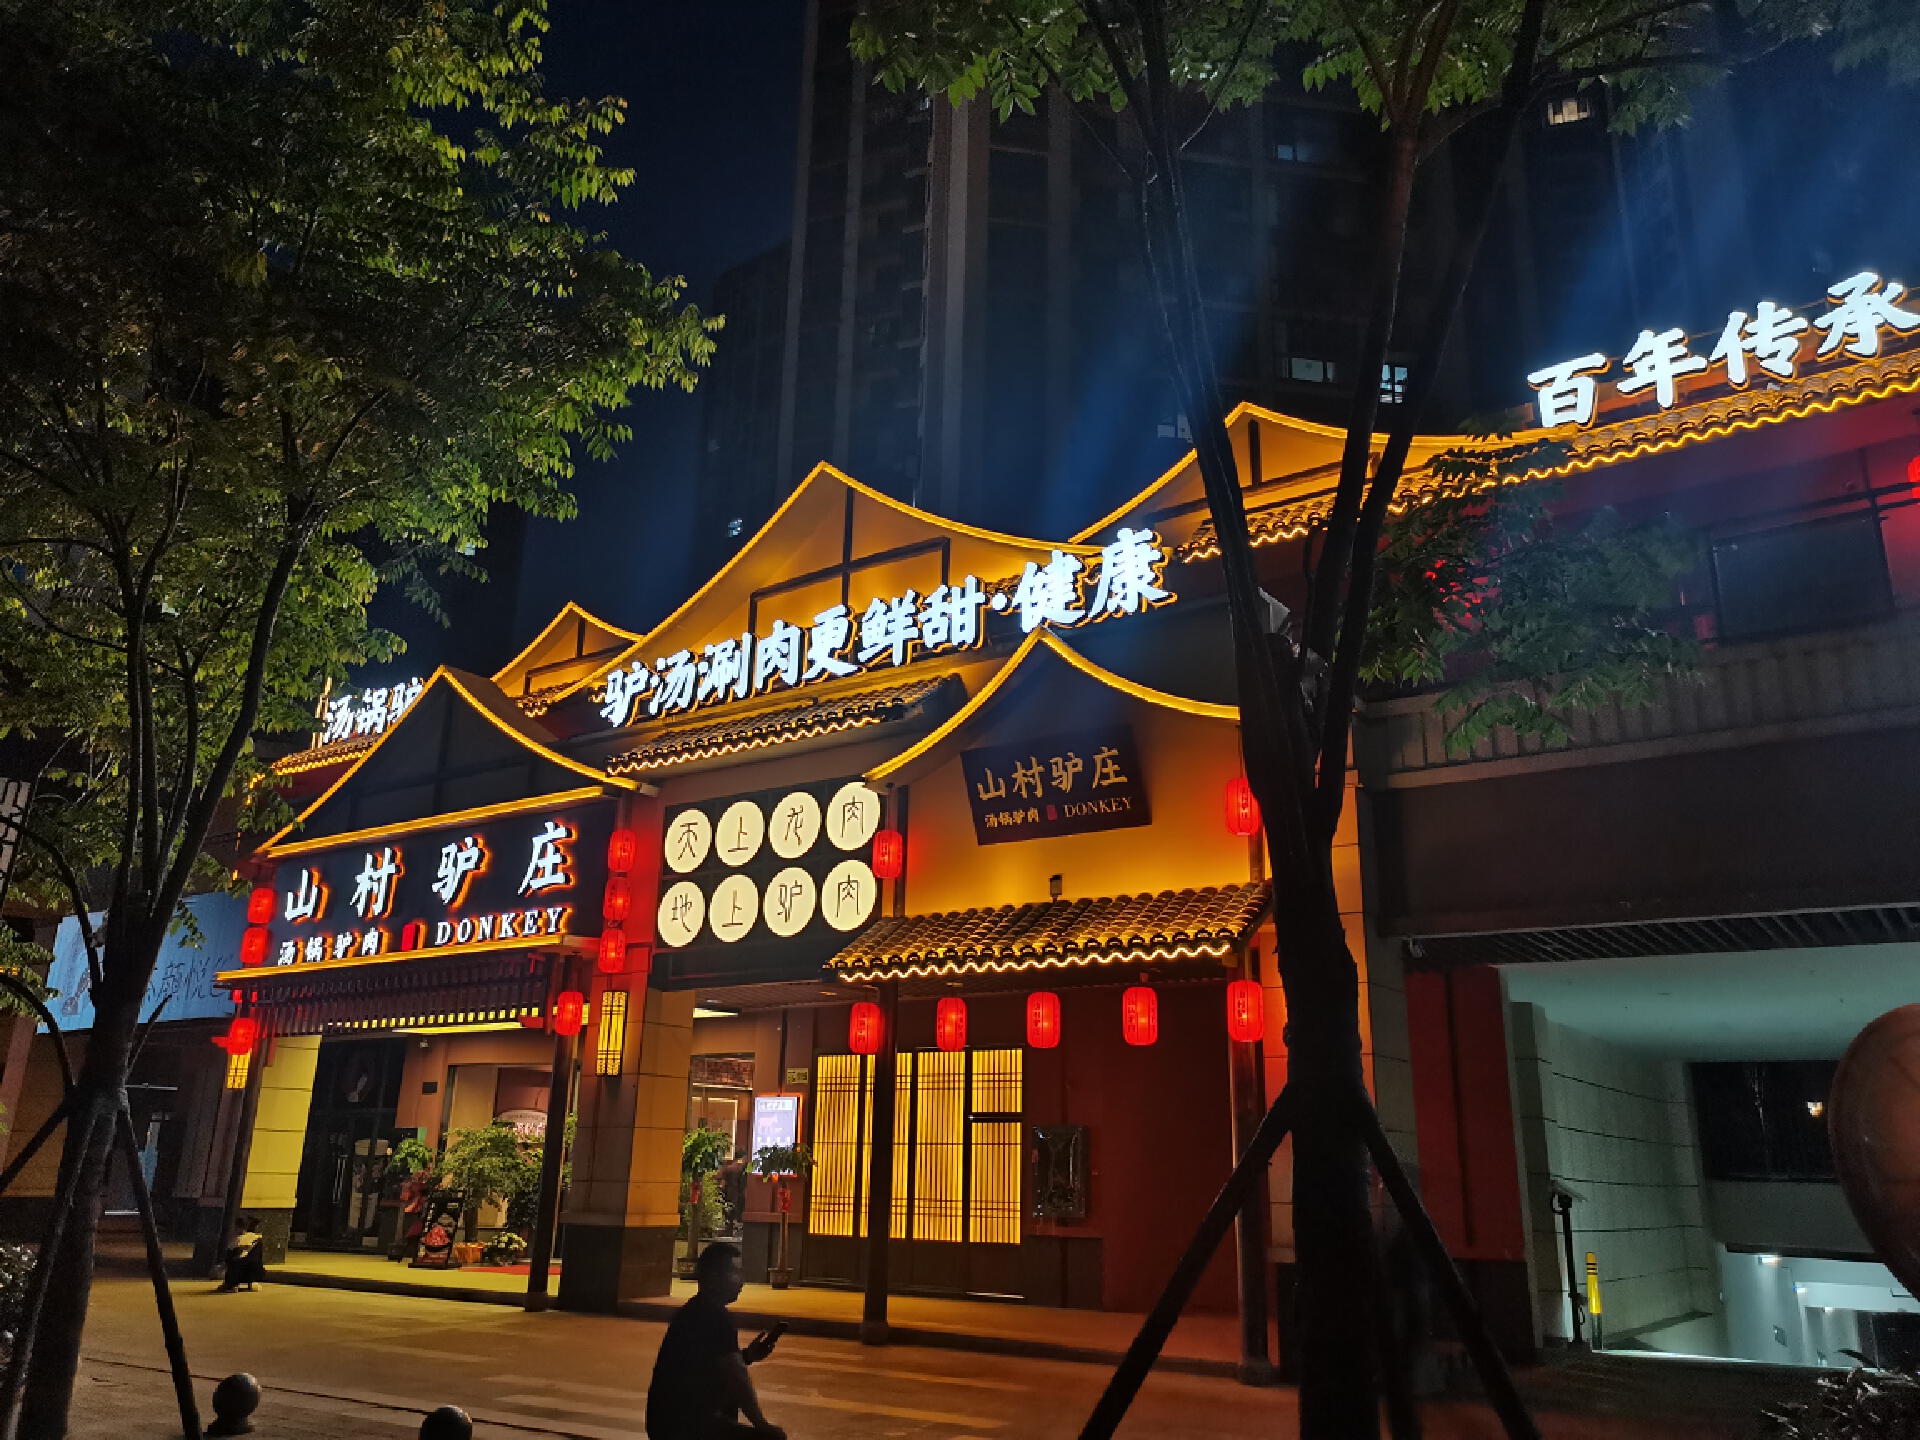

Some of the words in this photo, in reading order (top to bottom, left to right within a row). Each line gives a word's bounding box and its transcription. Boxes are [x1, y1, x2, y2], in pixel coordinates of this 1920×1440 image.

[1527, 271, 1920, 428] 百年传承
[976, 746, 1128, 801] 山村驴庄
[1063, 797, 1132, 818] DONKEY
[284, 821, 571, 922] 山村驴庄
[435, 907, 564, 946] DONKEY
[670, 874, 861, 932] 地上驴肉
[276, 928, 382, 966] 汤锅驴肉
